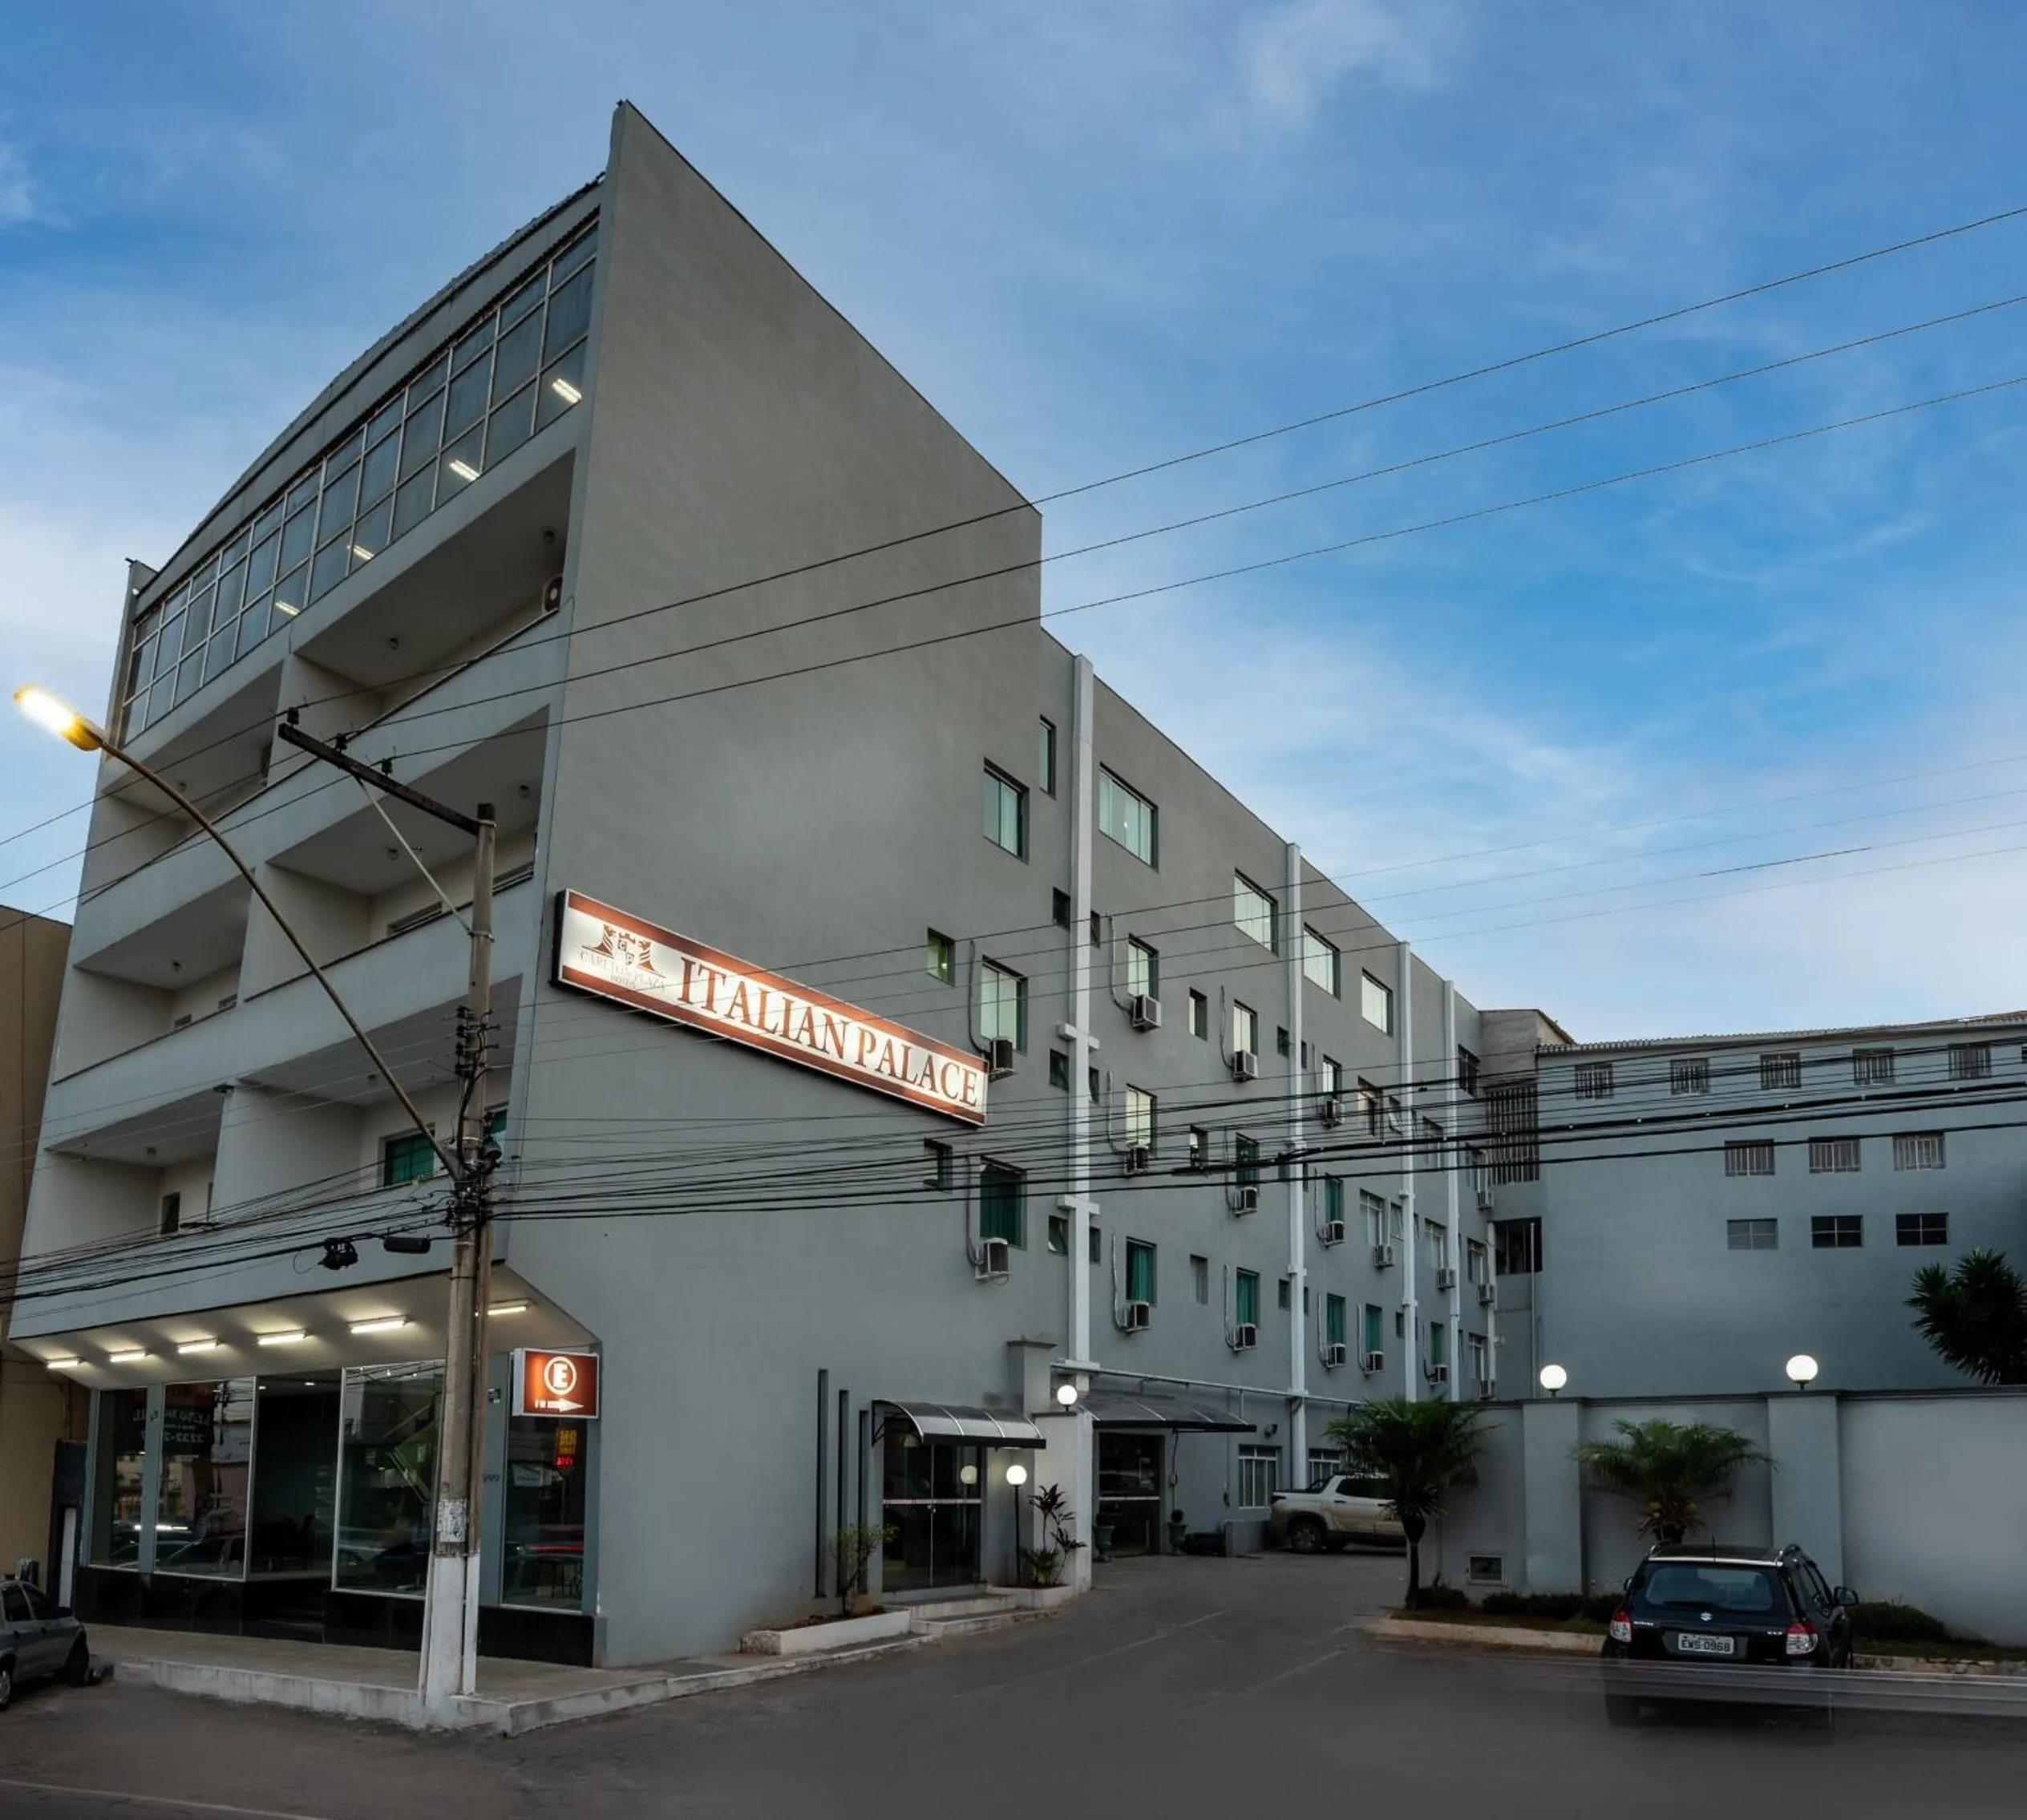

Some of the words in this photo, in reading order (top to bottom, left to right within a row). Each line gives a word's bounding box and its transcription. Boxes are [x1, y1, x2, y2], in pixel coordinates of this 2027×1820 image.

[677, 957, 851, 1058] ITALIAN
[854, 1026, 977, 1106] PALACE
[553, 1362, 568, 1387] E
